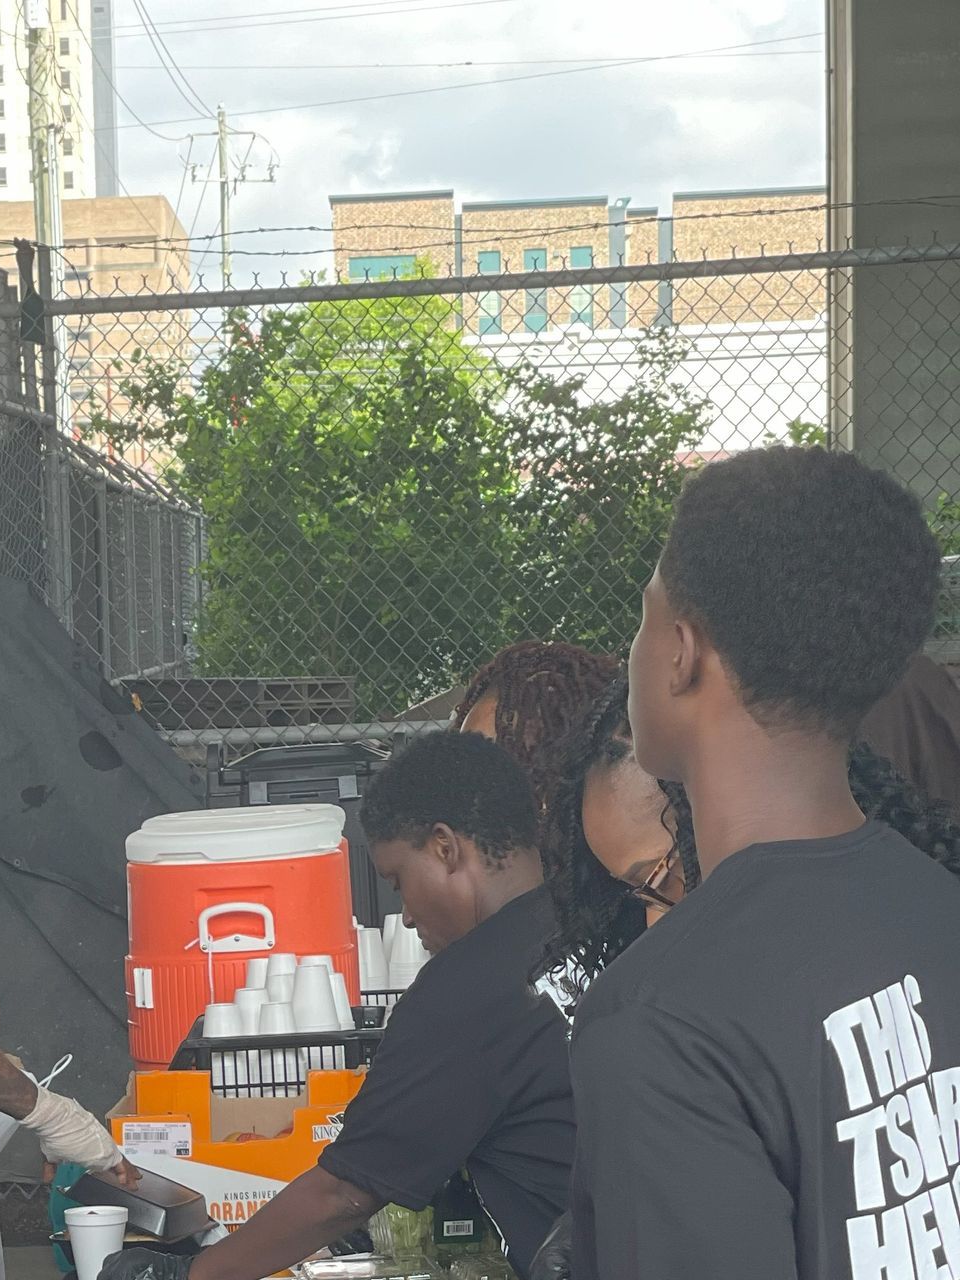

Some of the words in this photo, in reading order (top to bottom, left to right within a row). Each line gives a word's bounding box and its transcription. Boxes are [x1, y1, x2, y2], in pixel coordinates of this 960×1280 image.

[823, 974, 932, 1111] THIS
[224, 1191, 250, 1201] KINGS
[210, 1200, 268, 1221] ORAN
